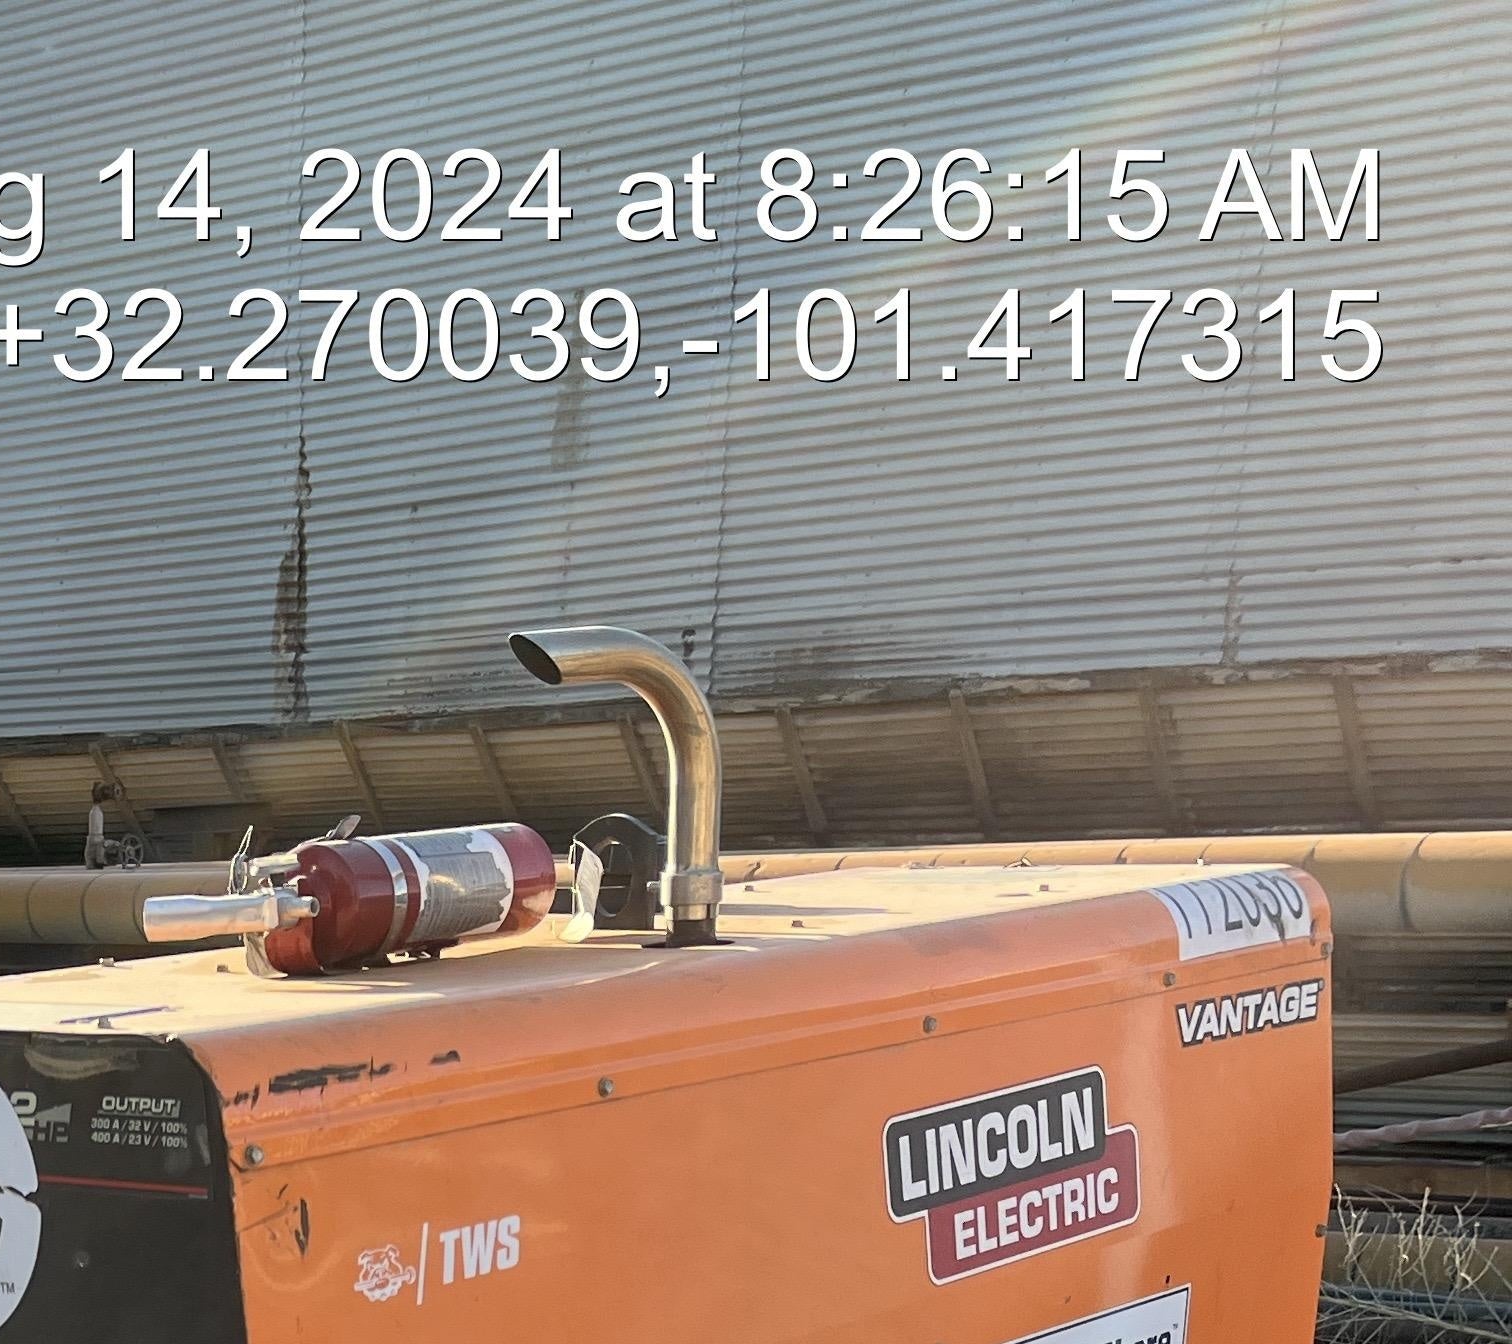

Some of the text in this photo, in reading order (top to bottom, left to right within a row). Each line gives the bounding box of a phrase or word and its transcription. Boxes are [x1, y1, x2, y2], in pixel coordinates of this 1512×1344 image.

[1177, 980, 1320, 1044] VANTAGE
[102, 1096, 176, 1114] OUTPUT
[90, 1117, 109, 1129] 300
[112, 1118, 120, 1130] A
[142, 1120, 152, 1132] V
[161, 1122, 188, 1135] 100%
[90, 1132, 110, 1144] 400
[113, 1133, 120, 1144] A
[143, 1134, 153, 1146] V
[898, 1087, 1096, 1202] LINCOLN
[954, 1167, 1119, 1261] ELECTRIC
[439, 1214, 521, 1286] TWS
[0, 1281, 16, 1294] TM
